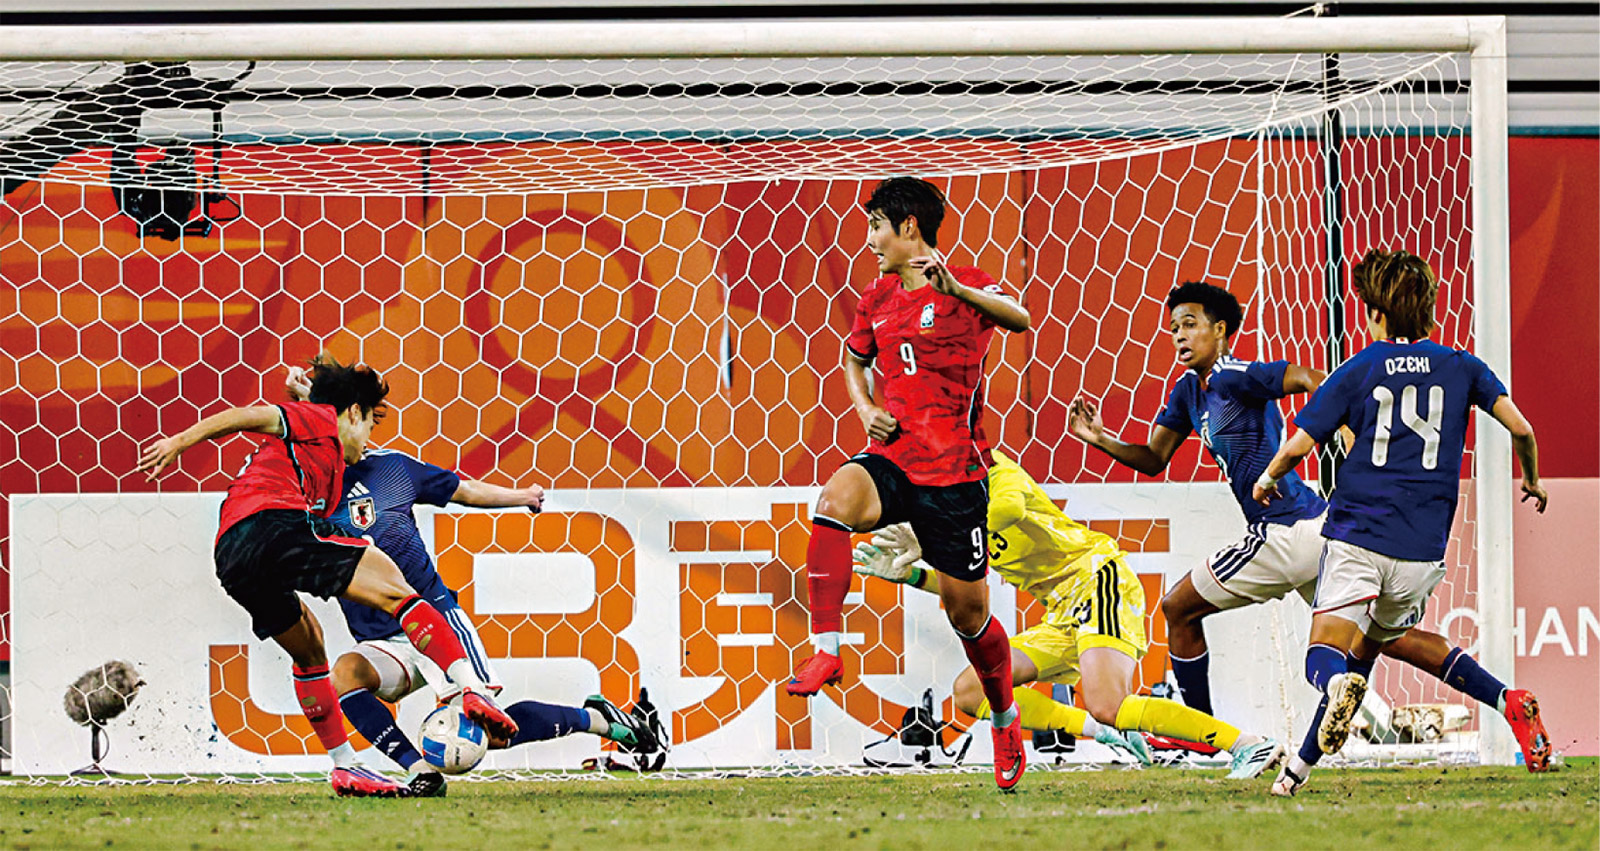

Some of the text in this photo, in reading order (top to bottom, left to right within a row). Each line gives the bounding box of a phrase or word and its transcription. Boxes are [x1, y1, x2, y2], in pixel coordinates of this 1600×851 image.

[899, 342, 917, 376] 9
[1385, 356, 1431, 375] OZEKI
[1371, 385, 1444, 470] 14
[970, 526, 984, 560] 9
[373, 724, 395, 746] APAN
